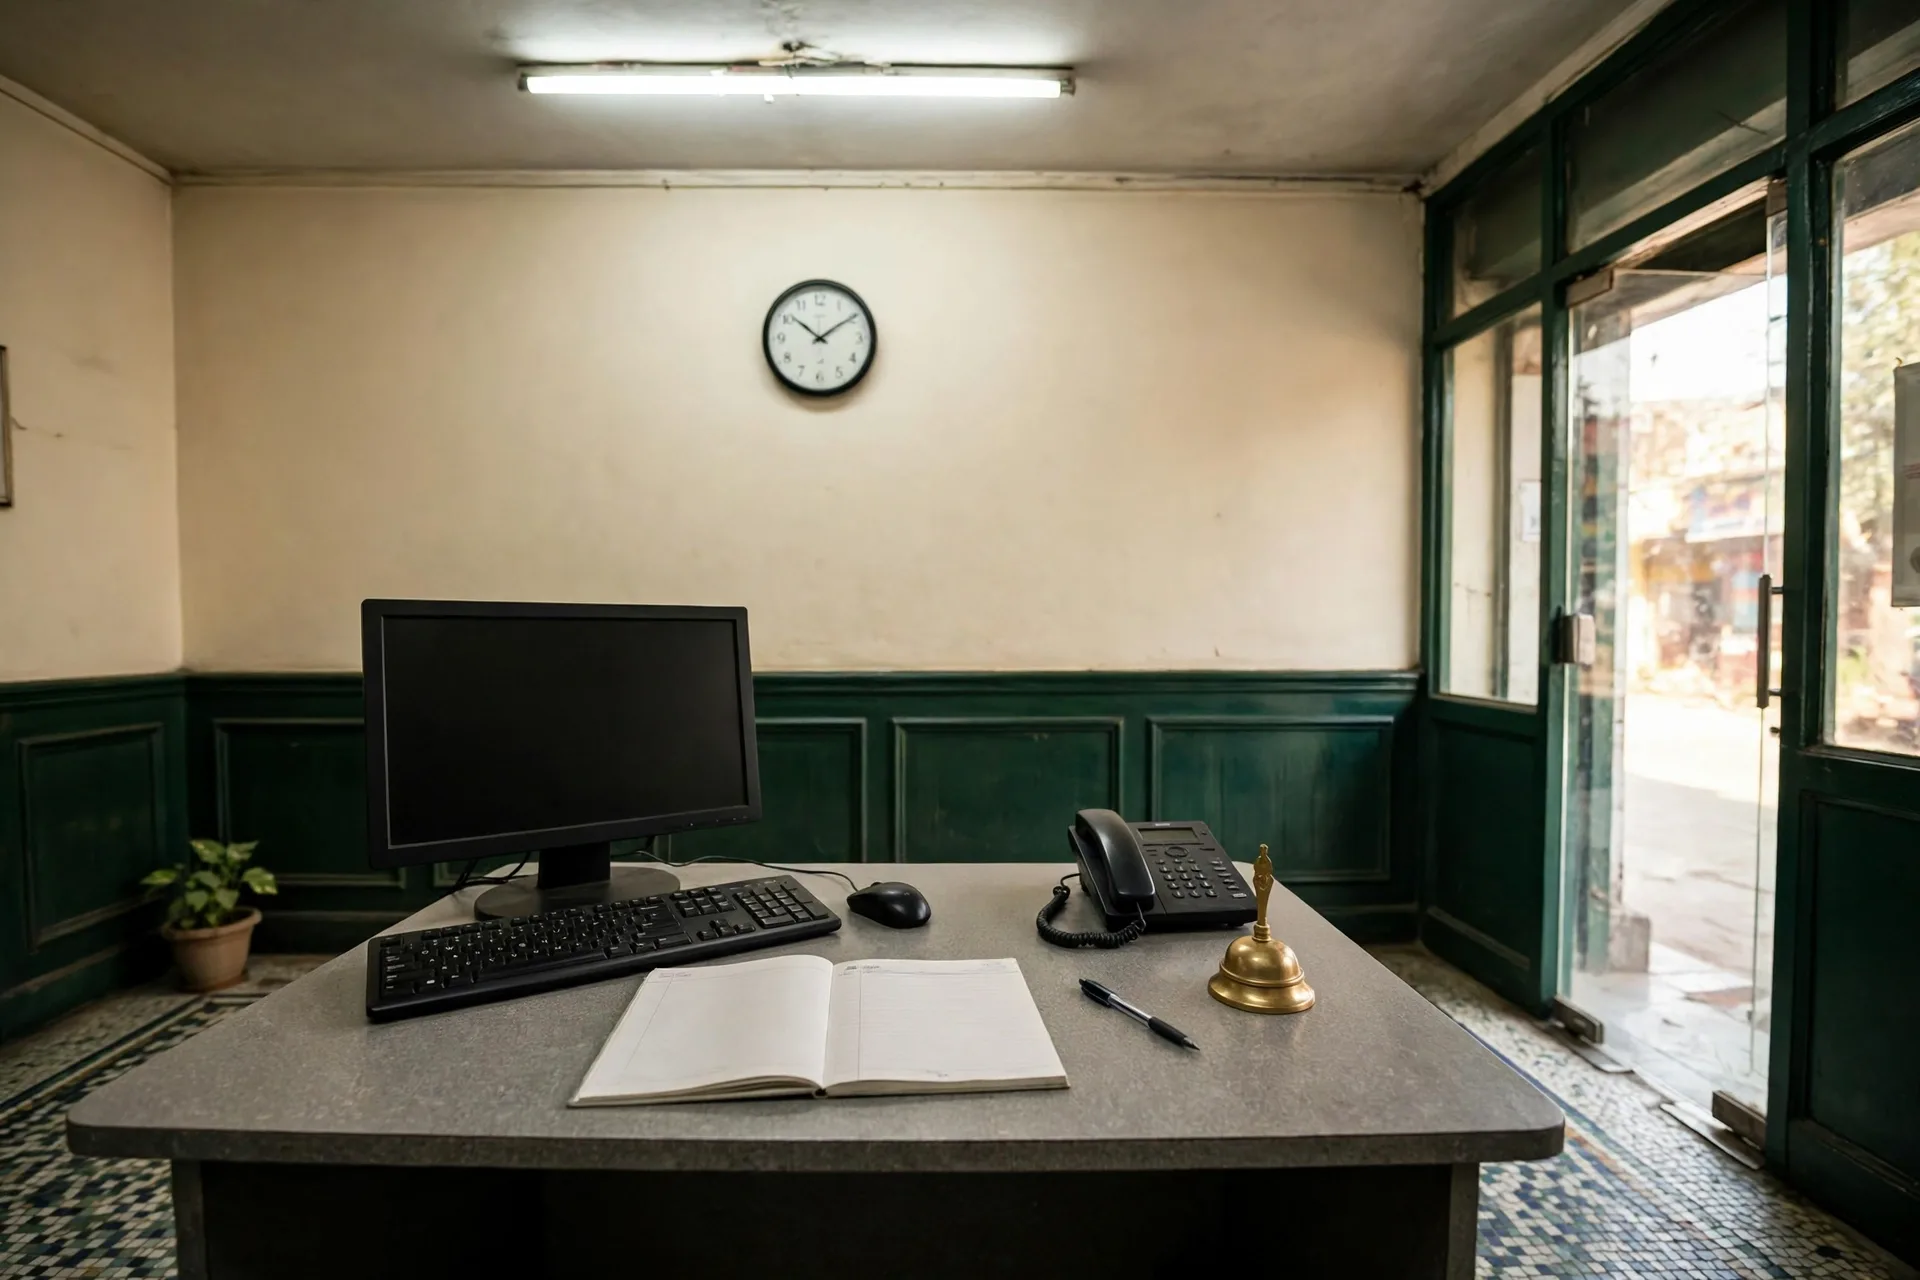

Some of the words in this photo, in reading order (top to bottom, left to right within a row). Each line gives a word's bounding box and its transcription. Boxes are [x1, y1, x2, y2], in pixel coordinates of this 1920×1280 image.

[796, 300, 806, 311] 11
[814, 293, 826, 306] 12
[777, 332, 786, 344] 9
[783, 352, 791, 364] 8
[848, 352, 857, 364] 4
[798, 364, 805, 377] 7
[835, 365, 844, 378] 5
